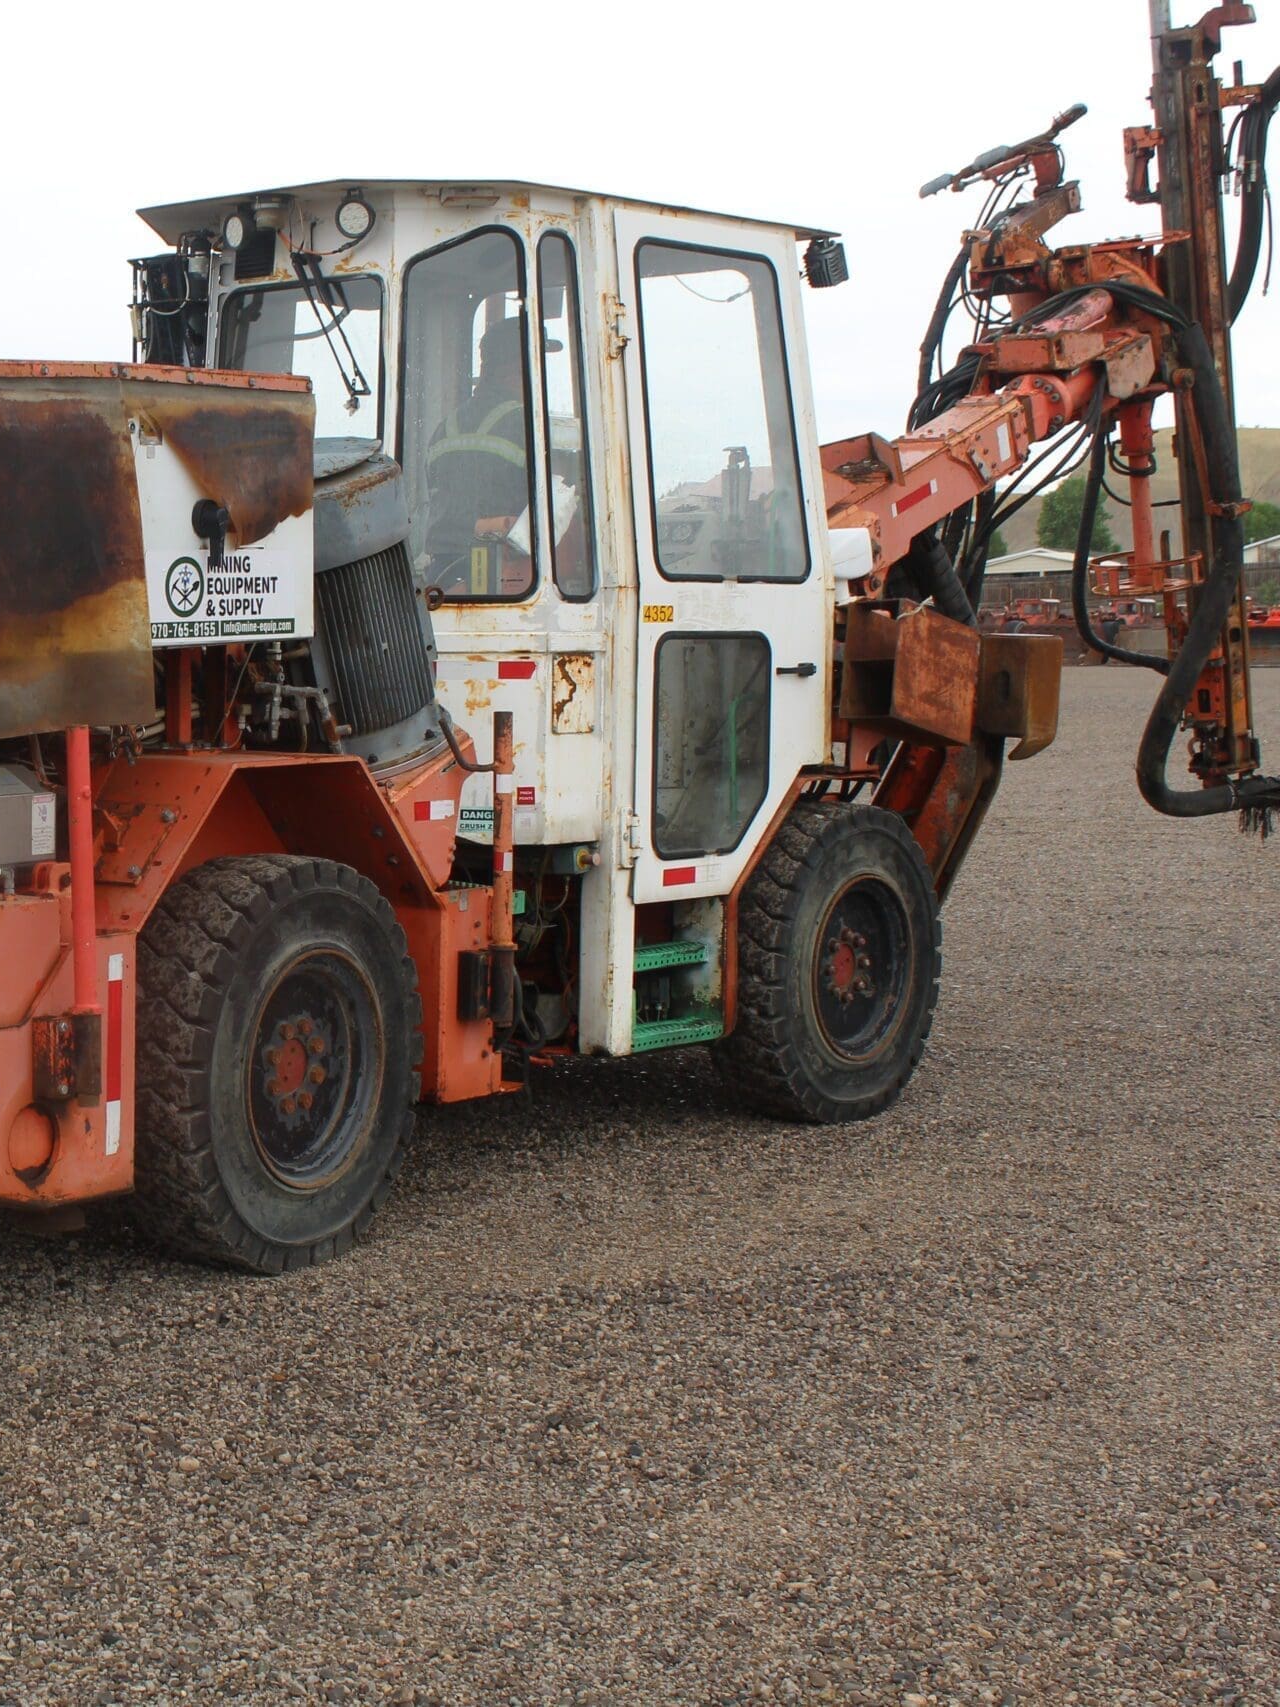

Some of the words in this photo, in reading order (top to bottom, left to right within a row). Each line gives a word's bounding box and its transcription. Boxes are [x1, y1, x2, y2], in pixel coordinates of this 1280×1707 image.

[207, 576, 278, 595] EQUIPMENT
[206, 599, 216, 616] &
[218, 598, 264, 616] SUPPLY
[644, 605, 674, 622] 4352
[151, 621, 216, 638] 970-765-8155
[223, 620, 292, 635] Info@mine-equip.com
[462, 810, 494, 820] DANG
